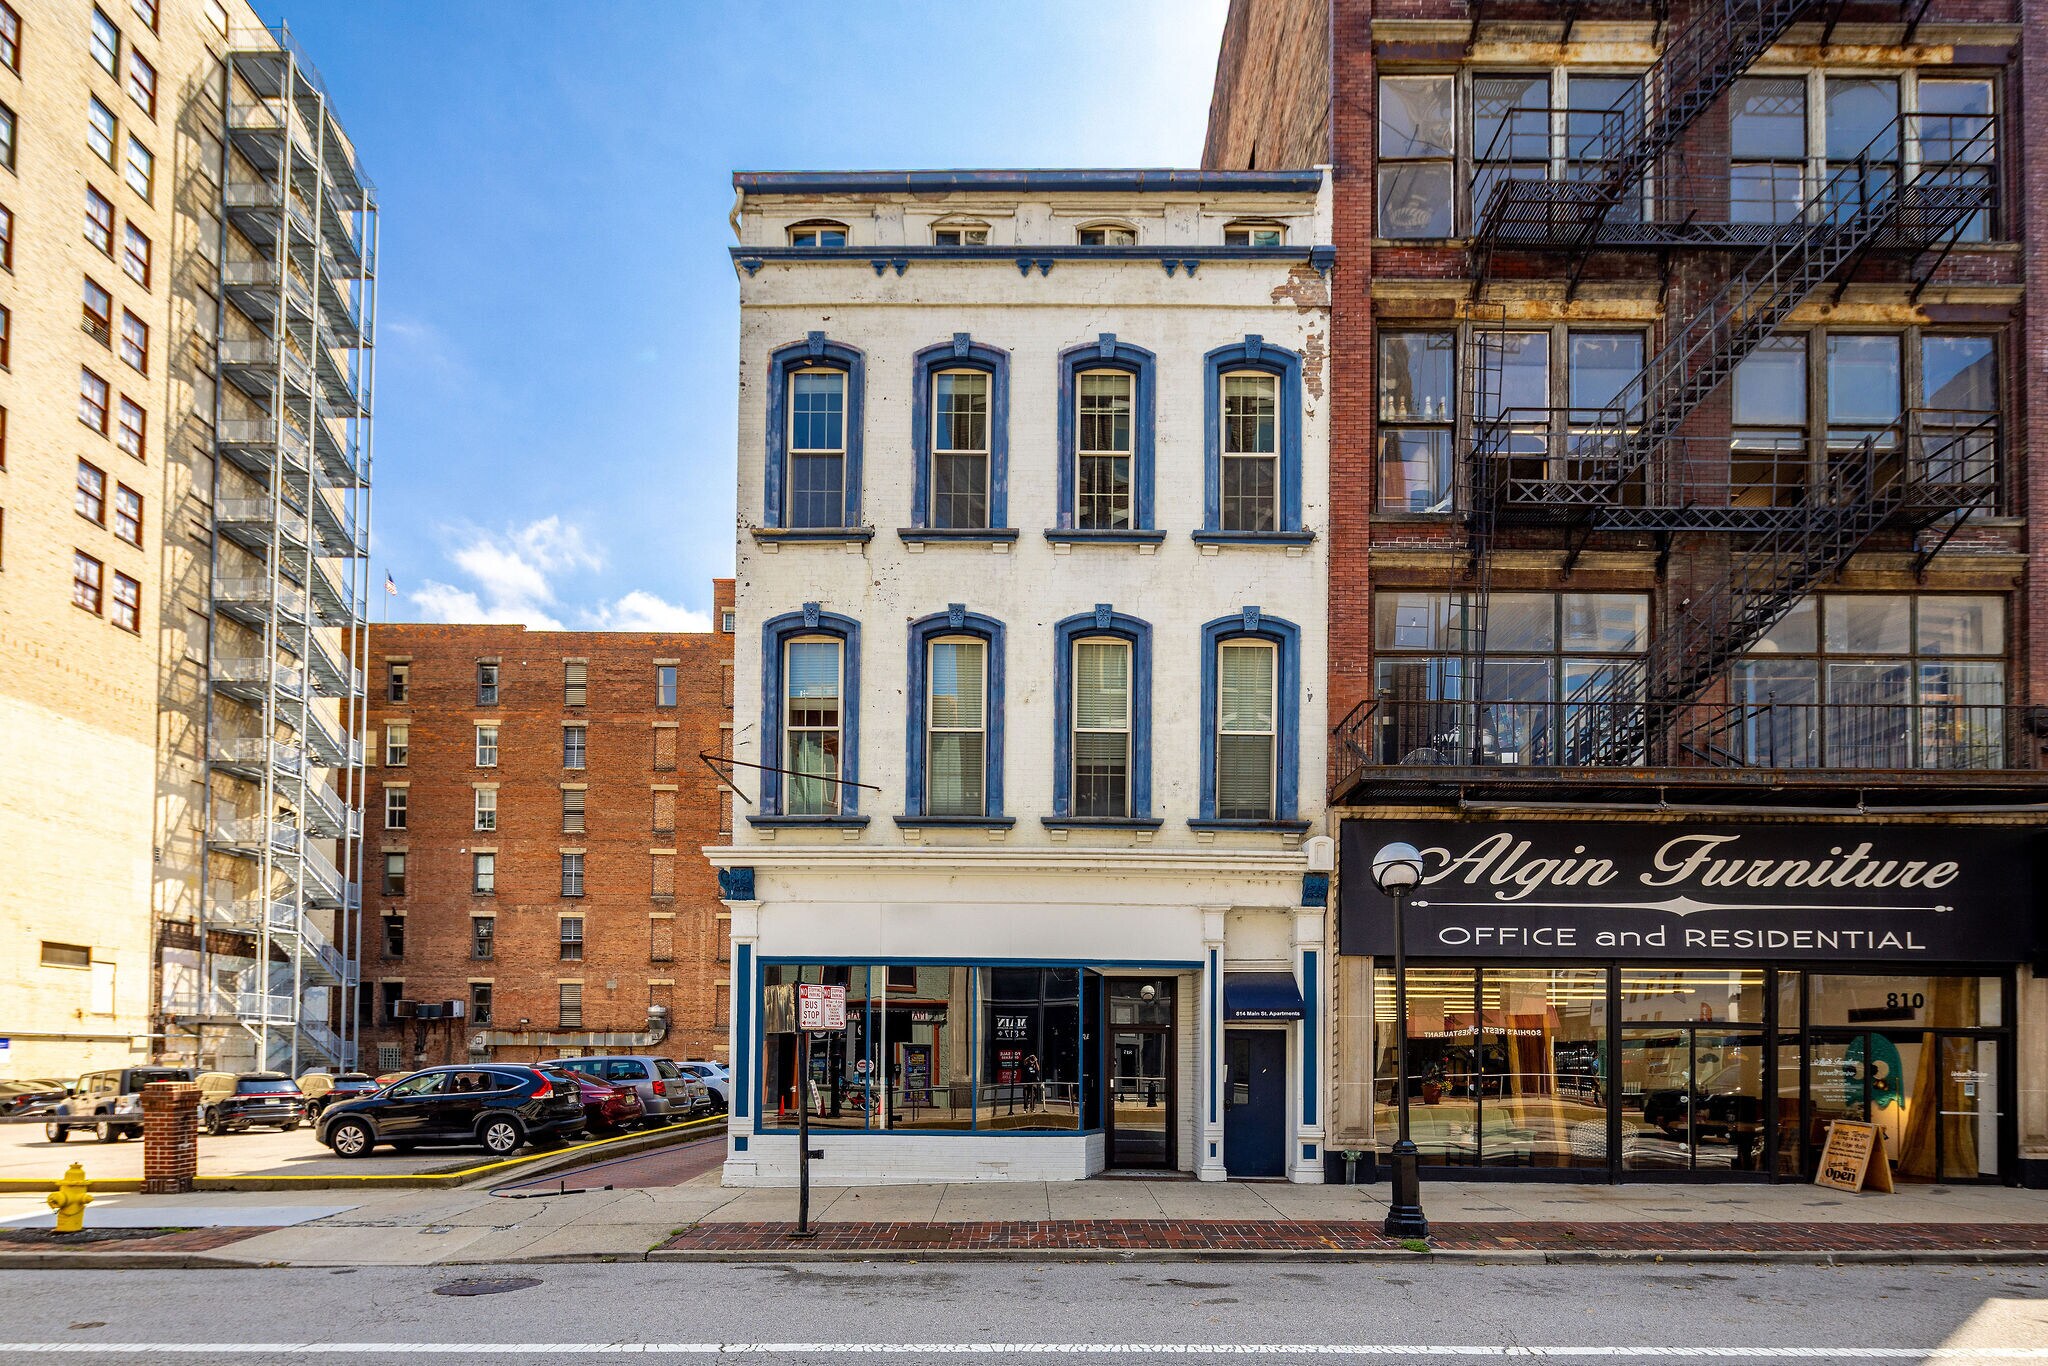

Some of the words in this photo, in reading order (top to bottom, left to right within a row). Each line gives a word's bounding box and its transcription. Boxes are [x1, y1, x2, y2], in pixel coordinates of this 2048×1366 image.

[1418, 832, 1619, 901] Algin
[1639, 834, 1960, 889] Furniture
[1438, 926, 1577, 946] OFFICE
[1595, 924, 1666, 947] and
[1685, 928, 1926, 950] RESIDENTIAL
[805, 1000, 818, 1009] BUS
[1887, 993, 1924, 1009] 810
[803, 1011, 820, 1019] STOP
[1825, 1167, 1856, 1182] Open
